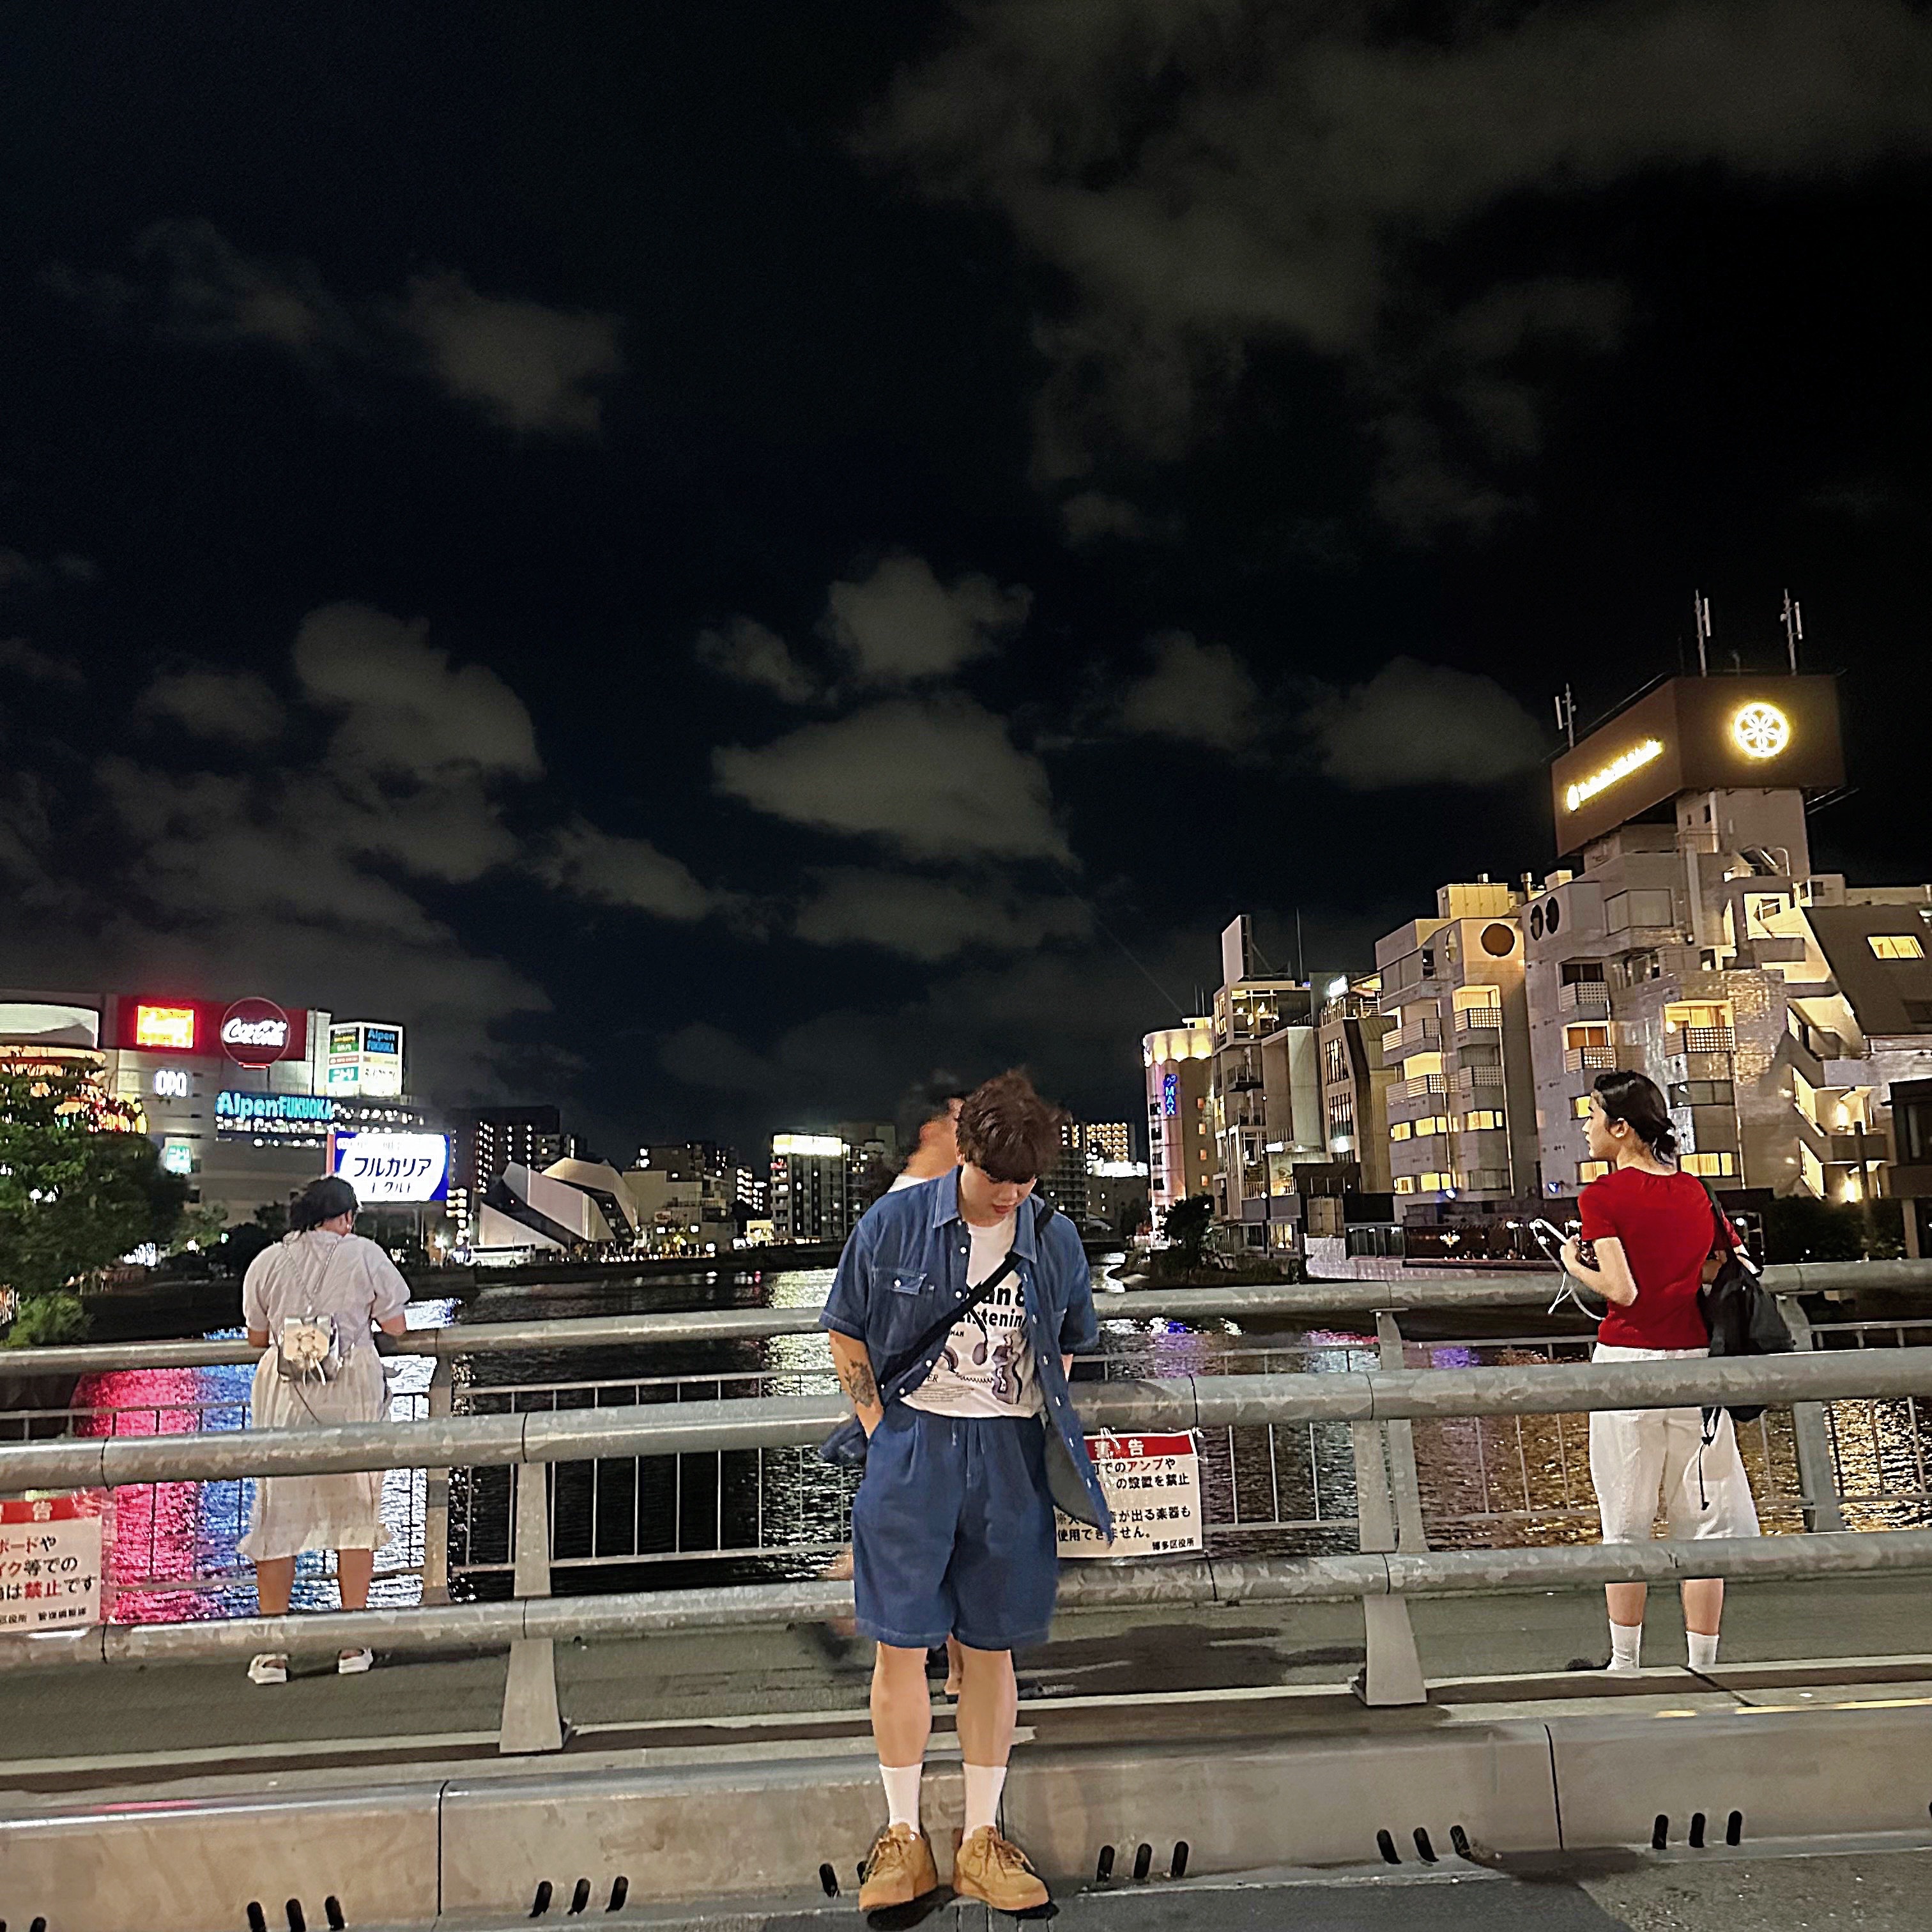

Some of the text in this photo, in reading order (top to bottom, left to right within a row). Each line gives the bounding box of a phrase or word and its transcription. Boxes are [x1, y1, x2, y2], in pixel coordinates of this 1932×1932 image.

[217, 1092, 278, 1120] Alpen
[0, 1575, 98, 1602] は禁止です
